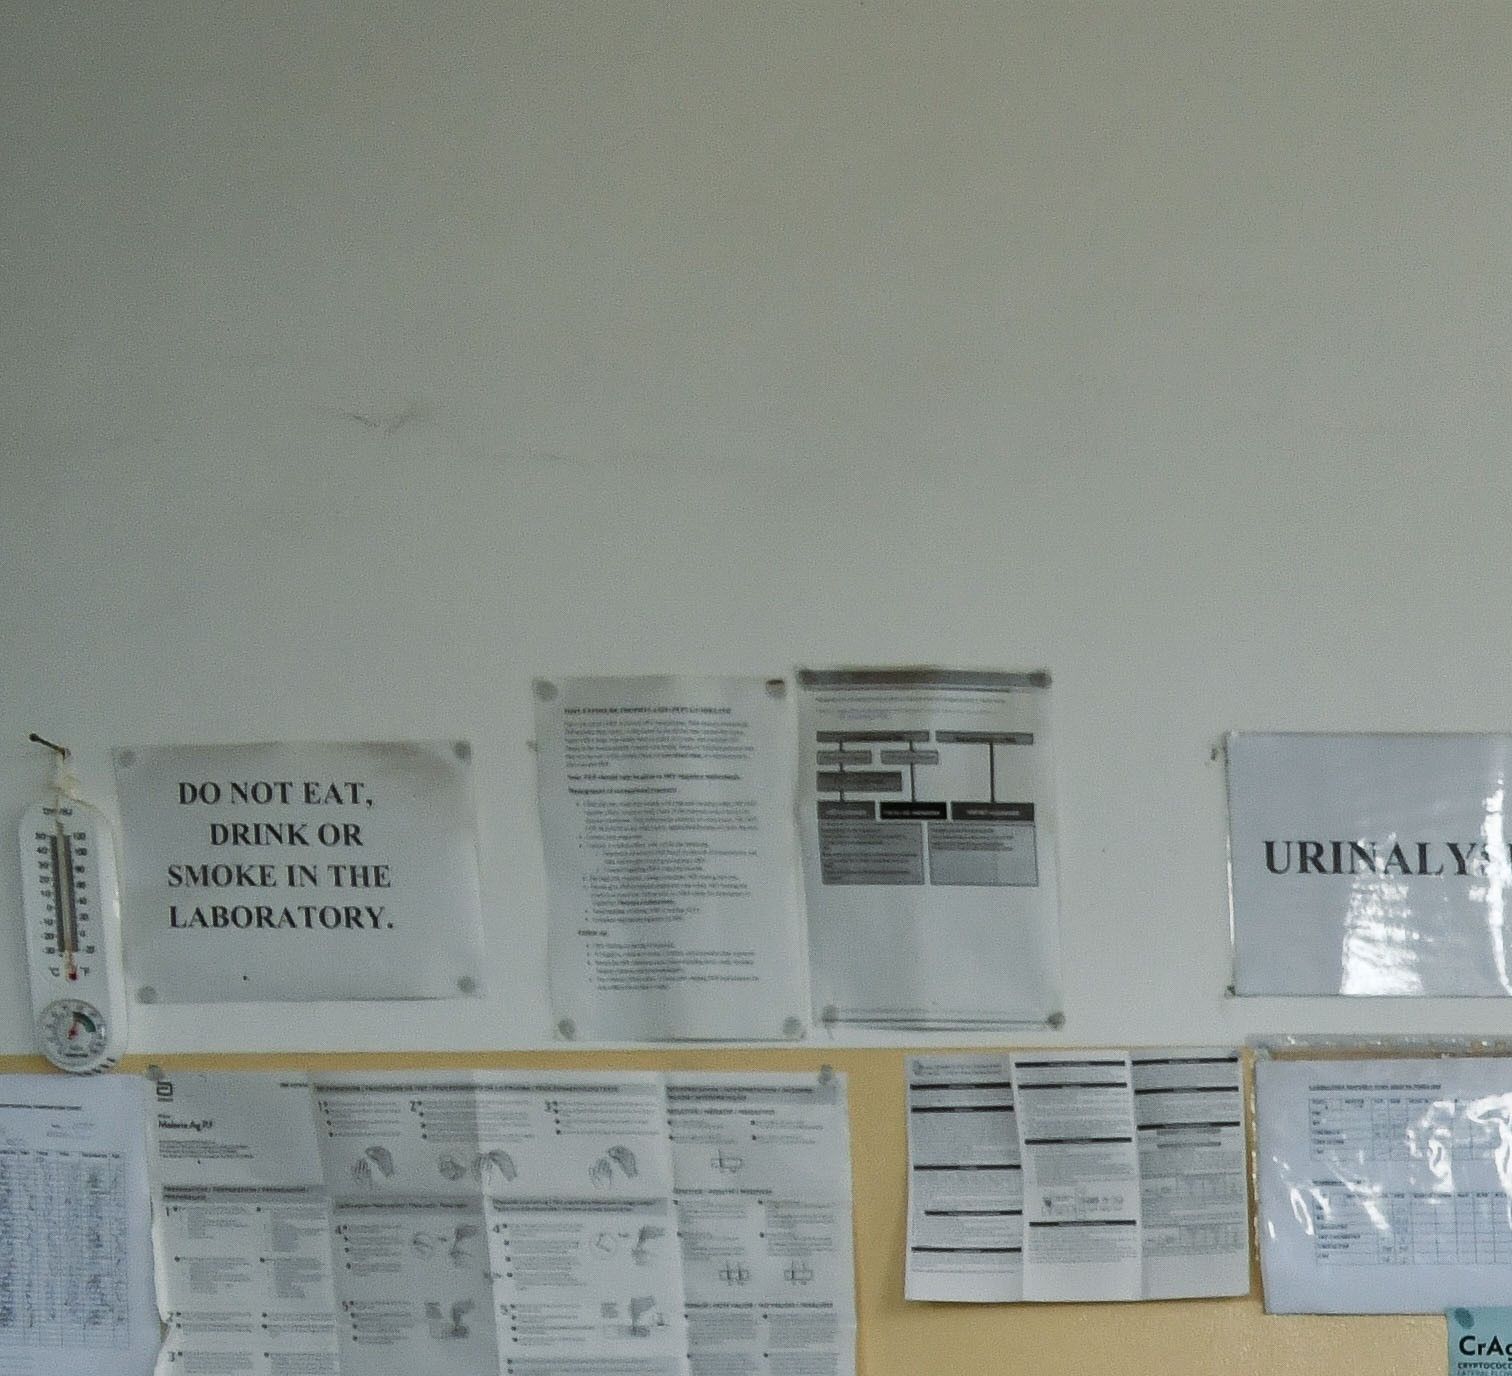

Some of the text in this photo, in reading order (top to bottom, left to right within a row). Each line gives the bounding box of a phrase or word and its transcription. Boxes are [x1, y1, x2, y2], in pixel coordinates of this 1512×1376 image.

[178, 781, 373, 808] DO NOT EAT,
[210, 822, 363, 846] DRINK OR
[168, 864, 391, 888] SMOKE IN THE
[169, 906, 394, 929] LABORATORY.
